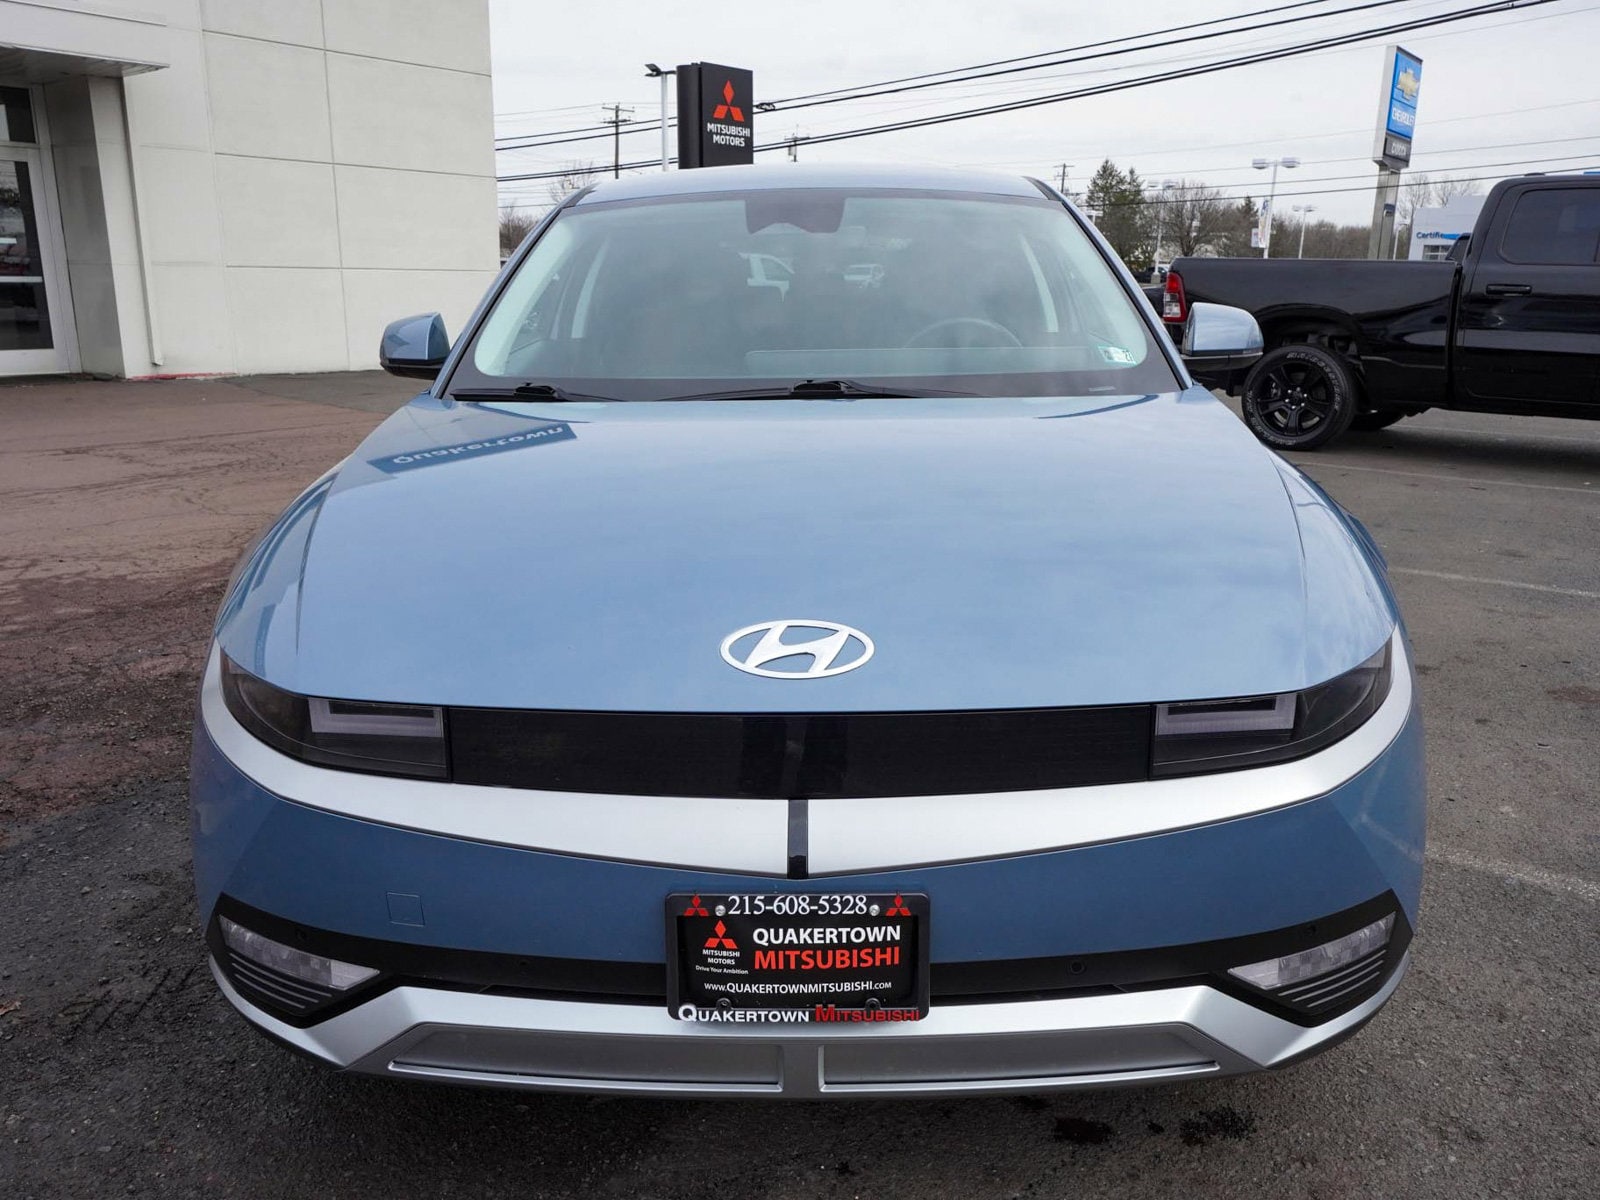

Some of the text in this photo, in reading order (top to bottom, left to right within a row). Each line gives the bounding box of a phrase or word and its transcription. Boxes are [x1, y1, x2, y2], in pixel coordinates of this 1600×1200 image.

[707, 122, 751, 137] MITSUBISHI
[713, 134, 745, 147] MOTORS
[728, 895, 868, 915] 215-608-5328
[752, 925, 901, 947] QUAKERTOWN
[702, 949, 740, 958] MITSUBISHI
[707, 957, 736, 965] MOTORS
[754, 946, 900, 970] MITSUBISHI
